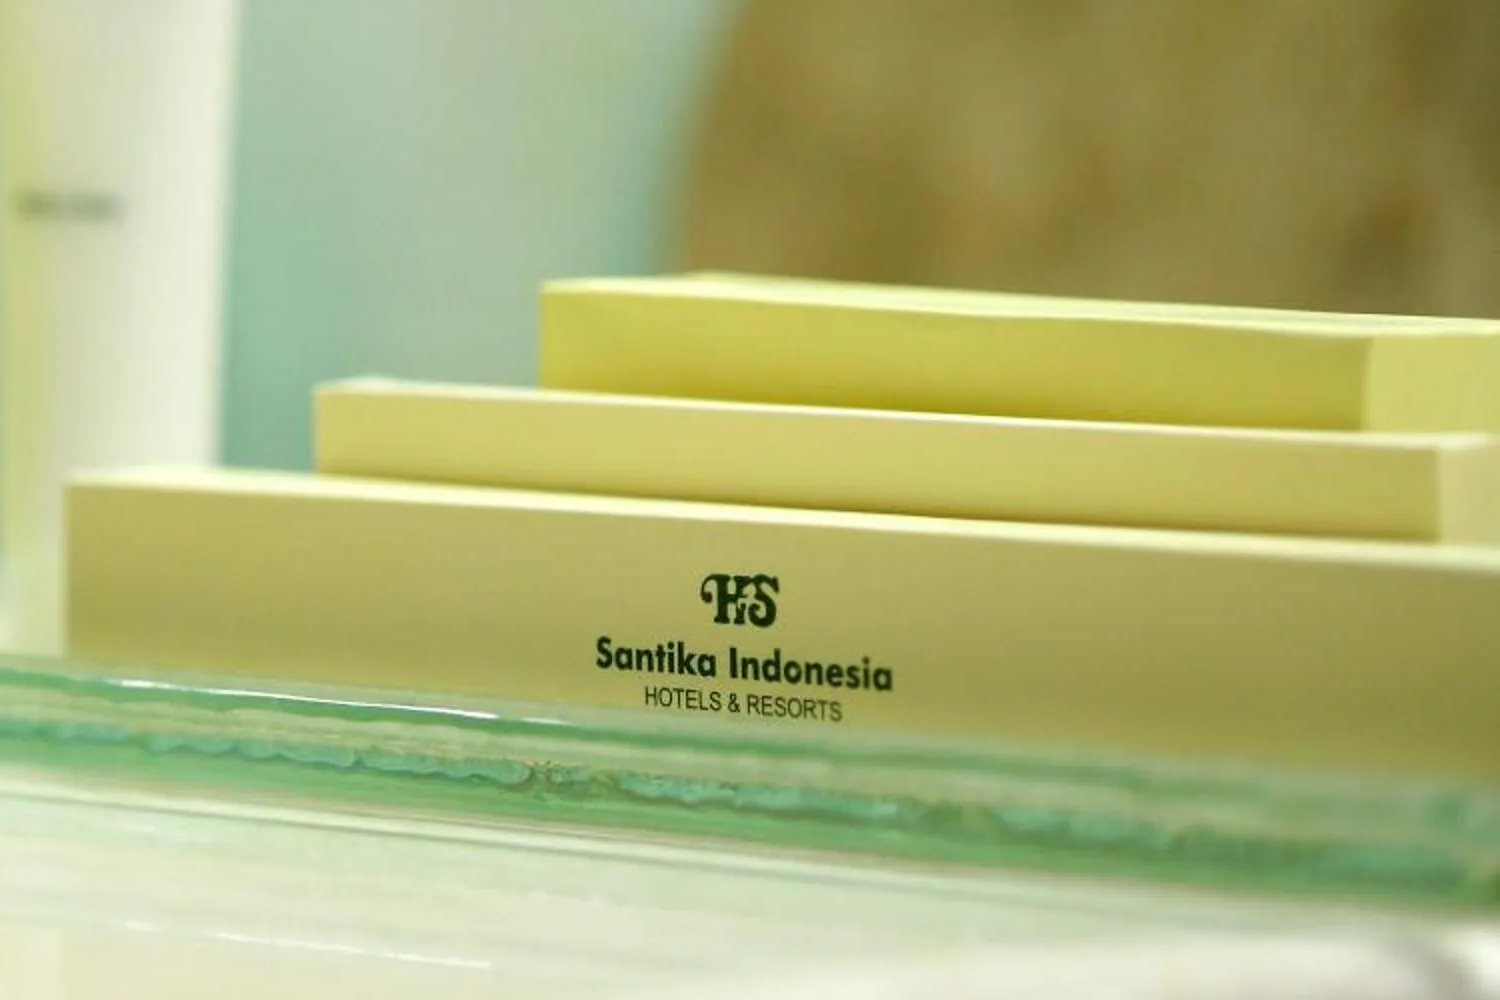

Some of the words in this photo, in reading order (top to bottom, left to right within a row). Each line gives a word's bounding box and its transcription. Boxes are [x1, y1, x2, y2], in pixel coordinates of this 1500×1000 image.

[596, 636, 717, 679] Santika
[729, 647, 894, 692] Indonesia
[645, 686, 722, 712] HOTELS
[727, 694, 741, 714] &
[747, 695, 843, 722] RESORTS
